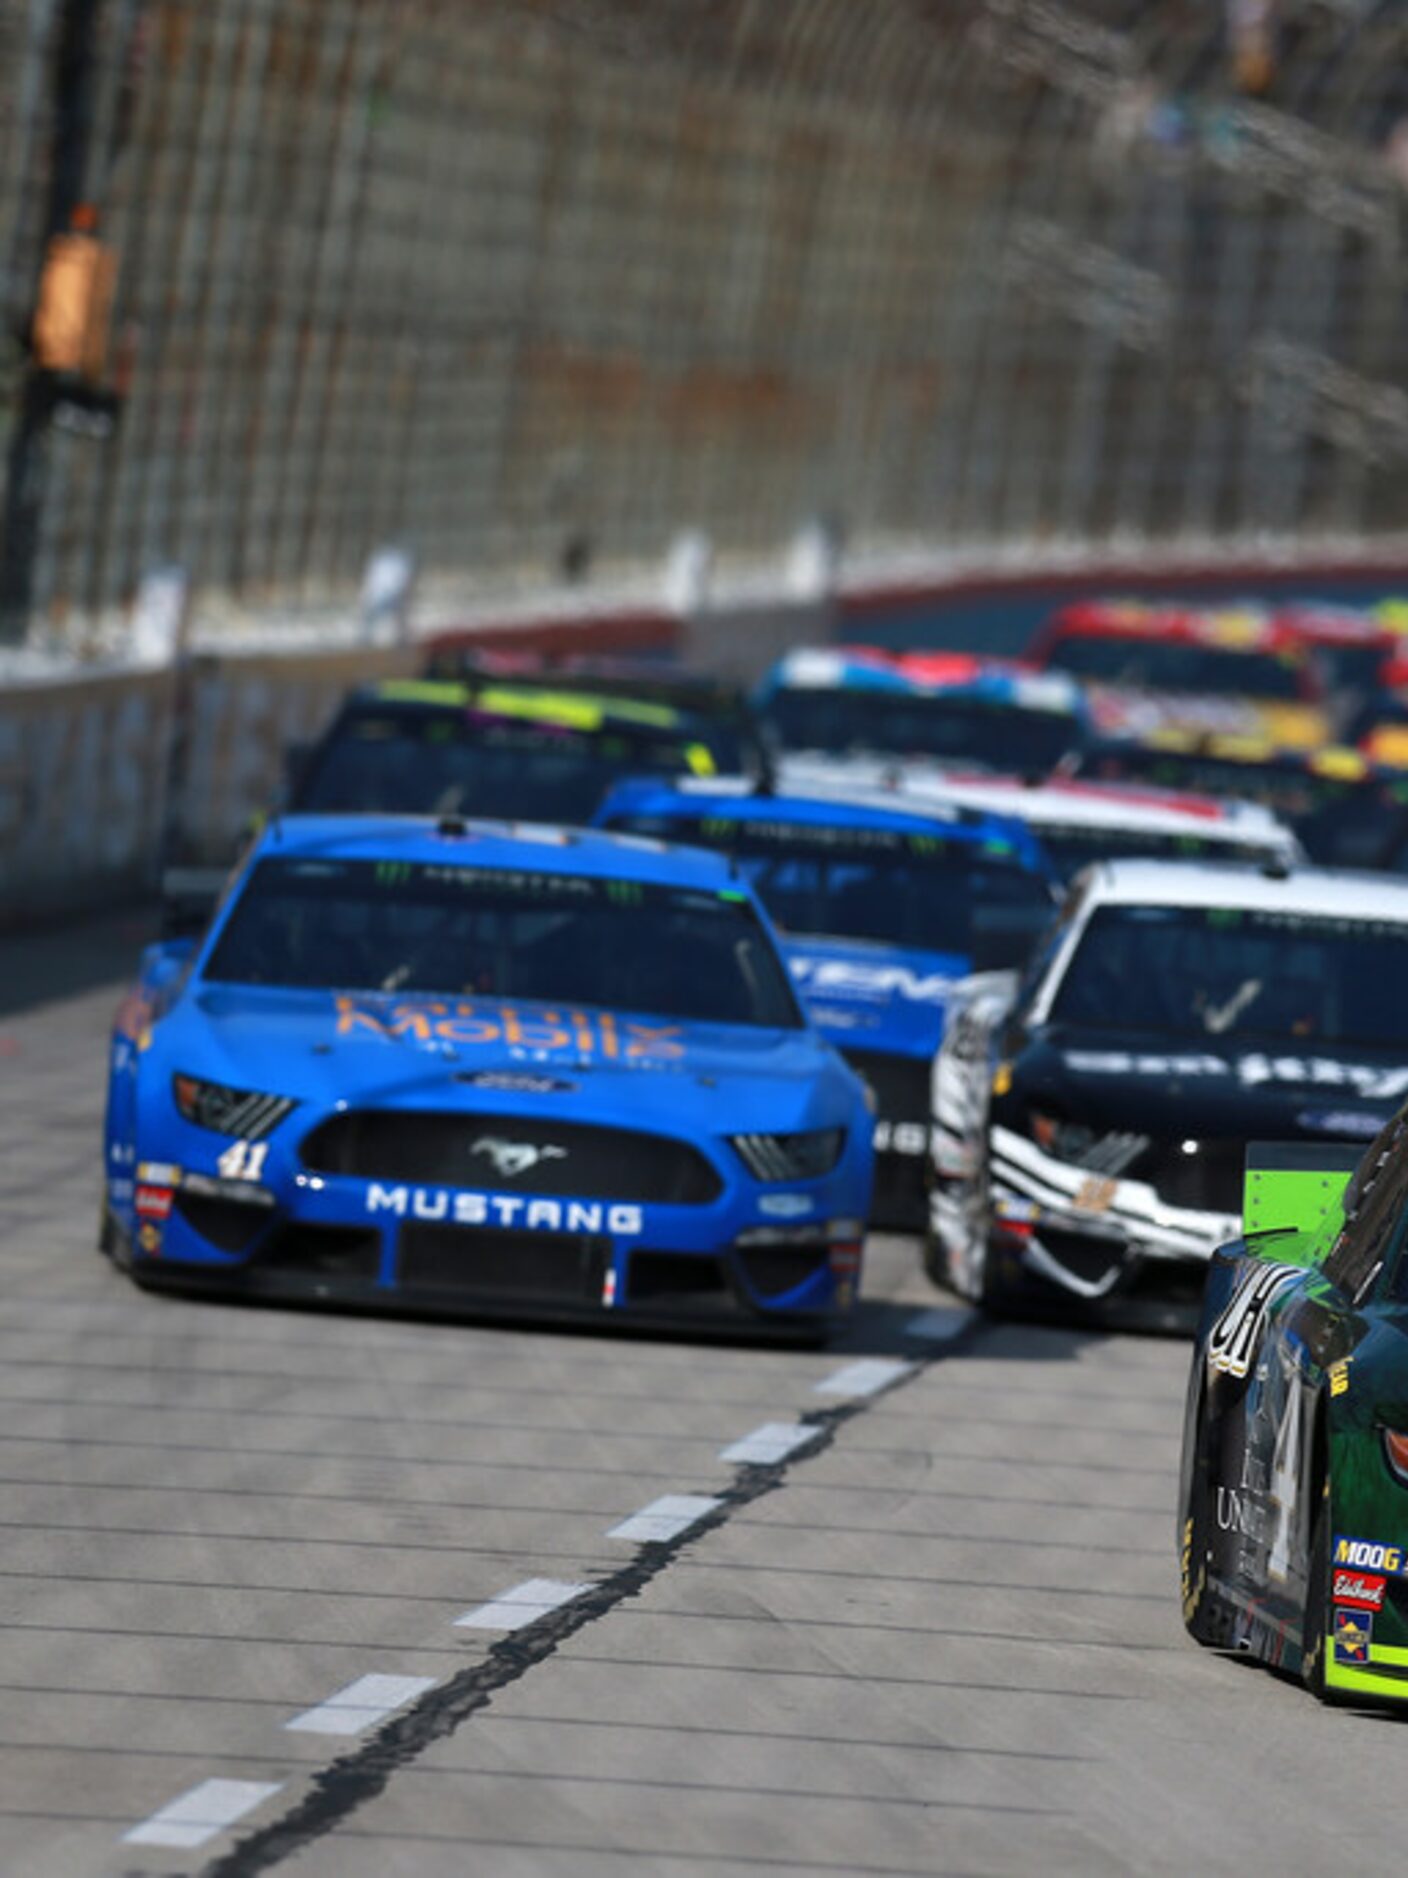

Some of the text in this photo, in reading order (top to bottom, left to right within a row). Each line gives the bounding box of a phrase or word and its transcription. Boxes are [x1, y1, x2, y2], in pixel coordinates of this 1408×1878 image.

[218, 1139, 268, 1181] 41
[366, 1183, 643, 1235] MUSTANG
[1333, 1538, 1401, 1572] MOOG
